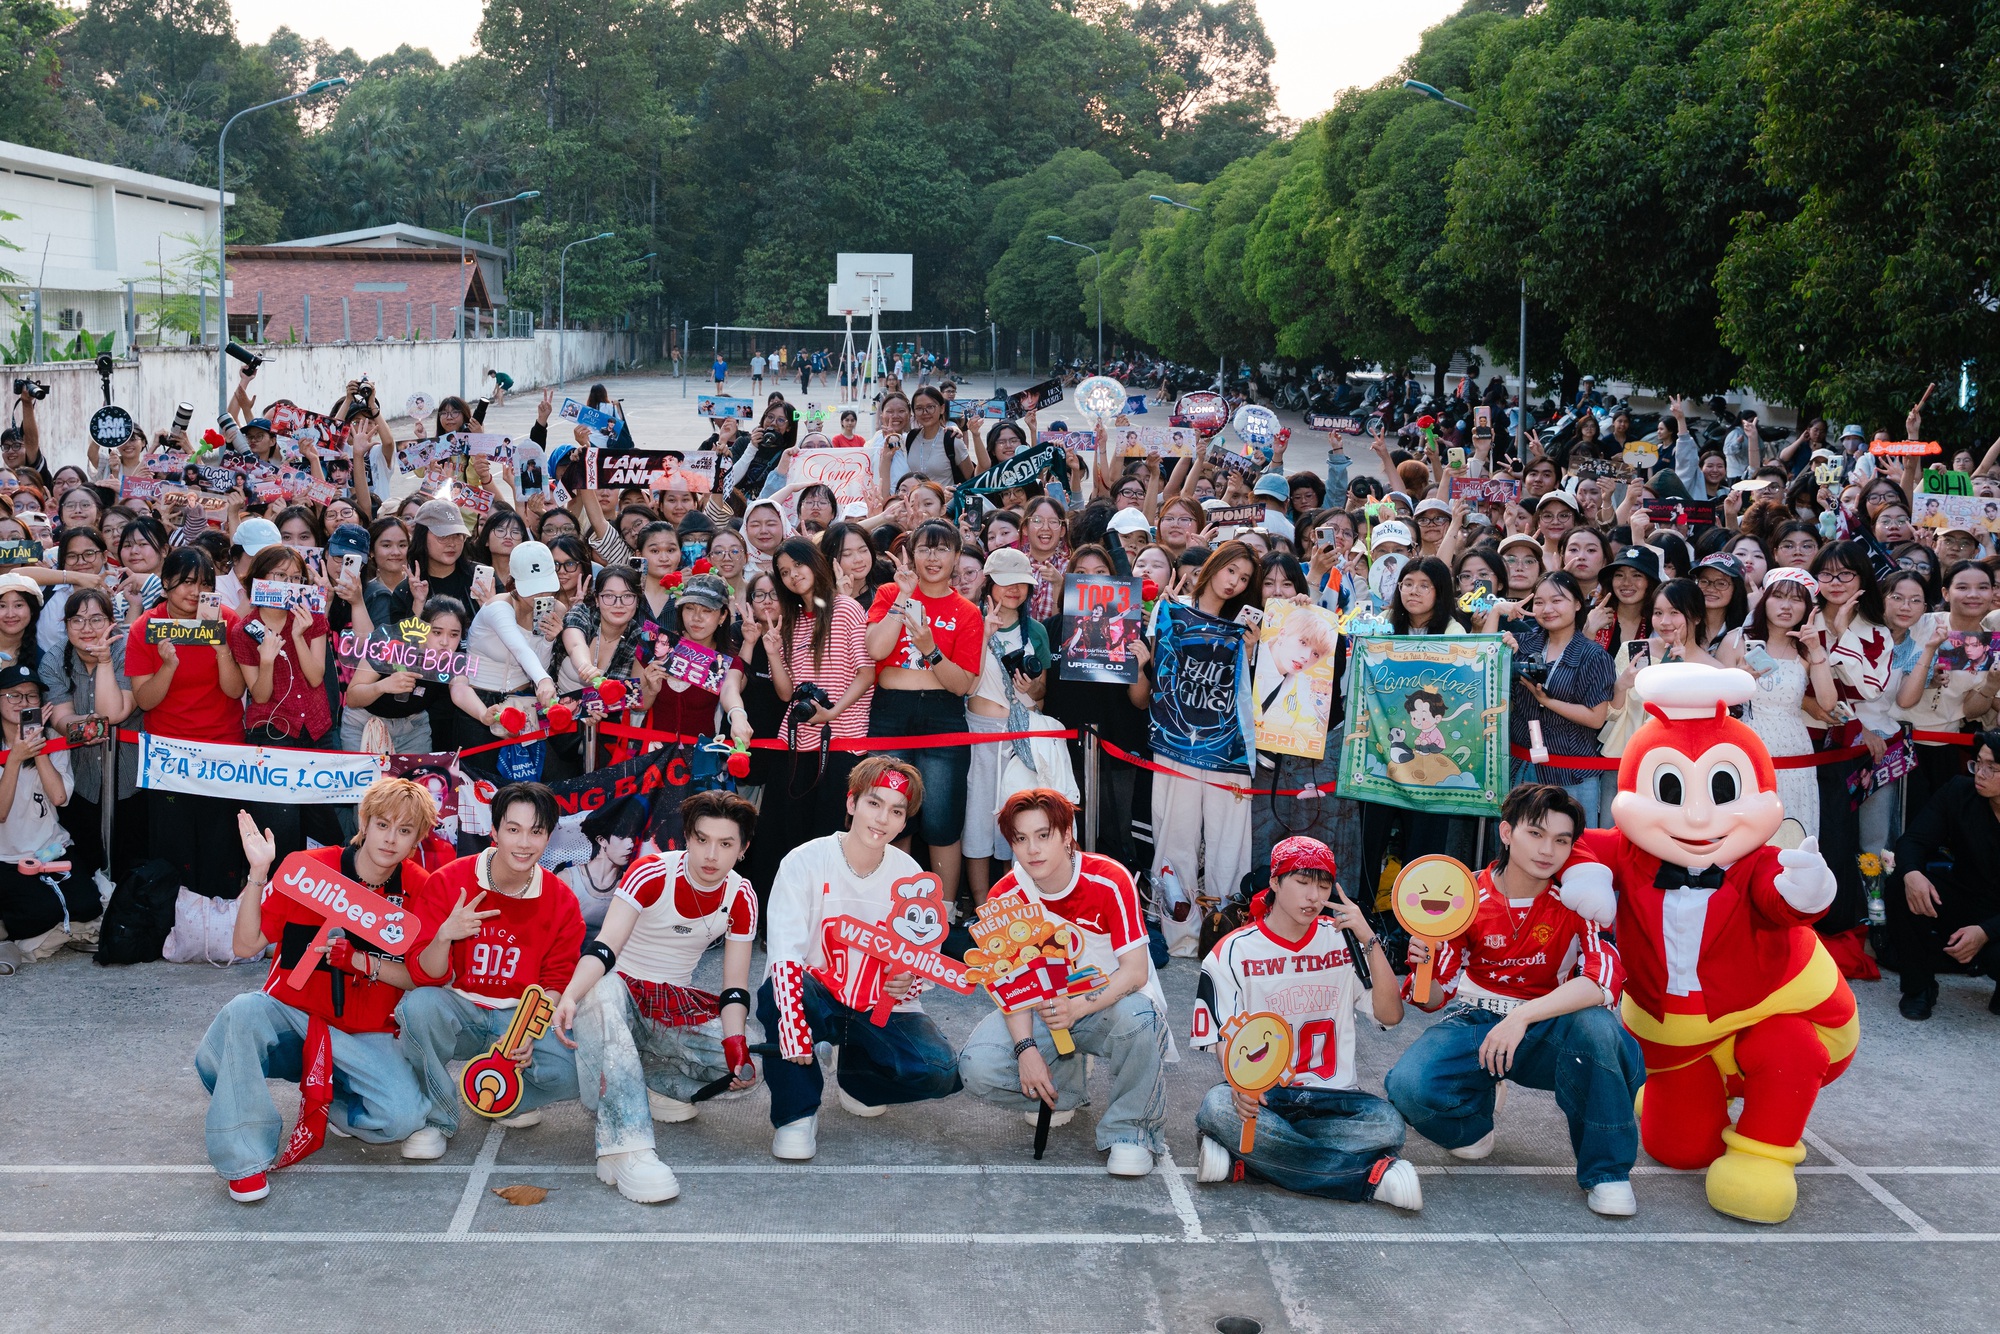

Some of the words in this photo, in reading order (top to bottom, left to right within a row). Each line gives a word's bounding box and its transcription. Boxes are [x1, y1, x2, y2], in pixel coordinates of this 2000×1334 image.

[98, 415, 124, 429] LÂM
[793, 410, 830, 421] DYLAN
[1313, 417, 1352, 428] WONBI
[97, 427, 126, 439] ANH
[1888, 444, 1926, 453] UPRIZE
[602, 455, 649, 470] LÂM
[608, 470, 660, 484] ANH
[1211, 507, 1257, 521] WONBI
[13, 545, 31, 558] LÂN
[1076, 584, 1115, 612] TOP
[1117, 586, 1131, 613] 3
[934, 616, 956, 631] bà
[156, 625, 167, 638] LÊ
[170, 629, 192, 638] DUY
[194, 626, 214, 639] LÂN
[1410, 652, 1421, 660] Petit
[1424, 653, 1440, 661] Prince
[1068, 661, 1104, 670] UPRIZE
[1367, 666, 1421, 694] Lâm
[1419, 668, 1482, 699] Anh
[296, 768, 374, 789] LONG
[283, 866, 377, 929] Jollibee
[979, 900, 1000, 919] MỞ
[1002, 896, 1020, 909] RA
[1011, 905, 1040, 920] VUI
[471, 943, 521, 979] 903
[839, 920, 874, 948] WE
[889, 942, 969, 989] Jollibee
[1291, 947, 1352, 973] TIMES
[1005, 986, 1031, 1000] Jollibee
